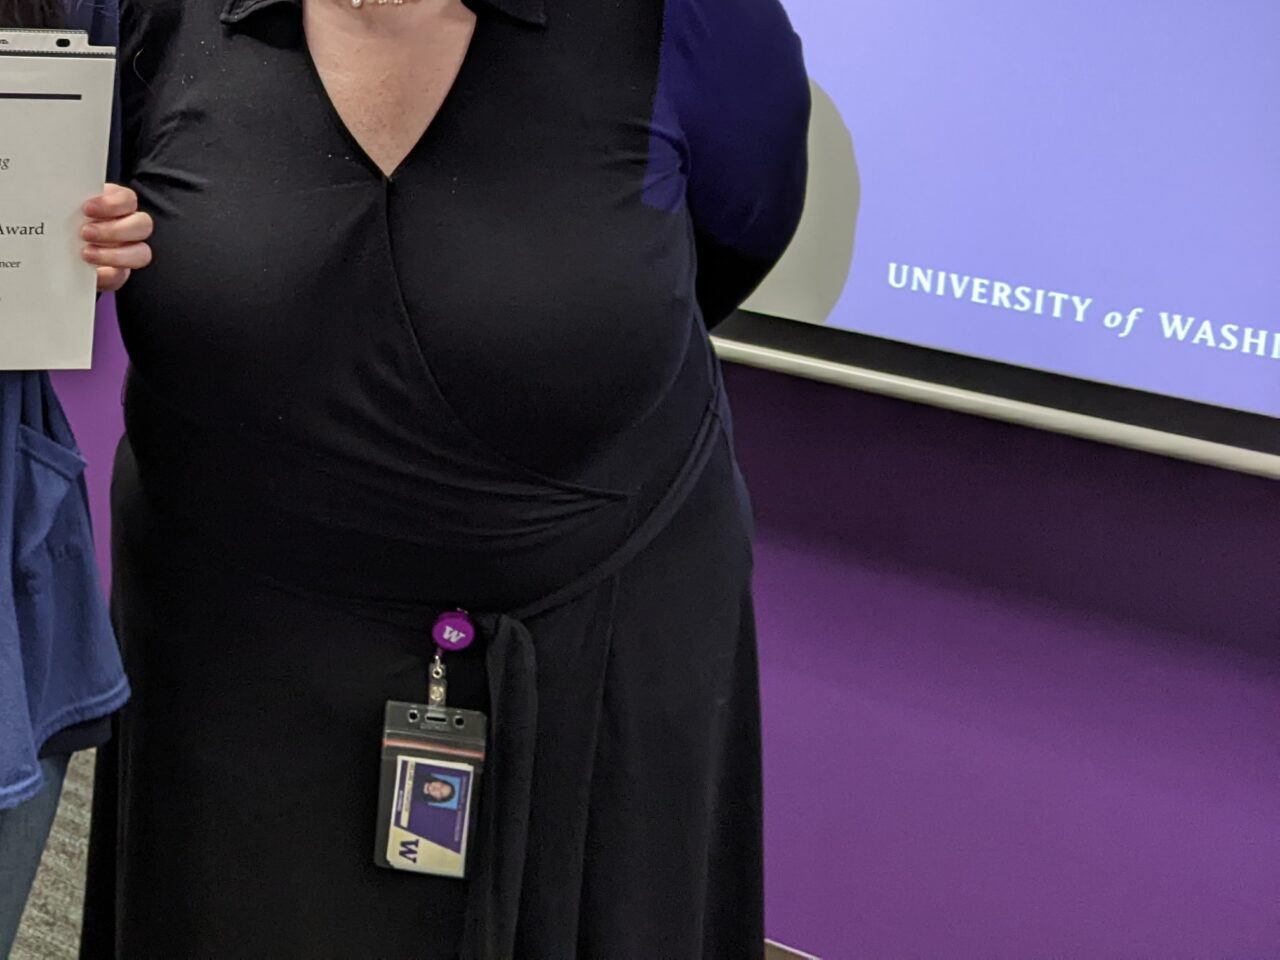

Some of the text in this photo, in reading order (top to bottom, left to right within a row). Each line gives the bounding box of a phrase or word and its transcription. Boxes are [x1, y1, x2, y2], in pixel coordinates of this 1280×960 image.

[888, 262, 1280, 359] UNIVERSITY of WASHI
[443, 625, 466, 644] W
[399, 839, 419, 863] W
